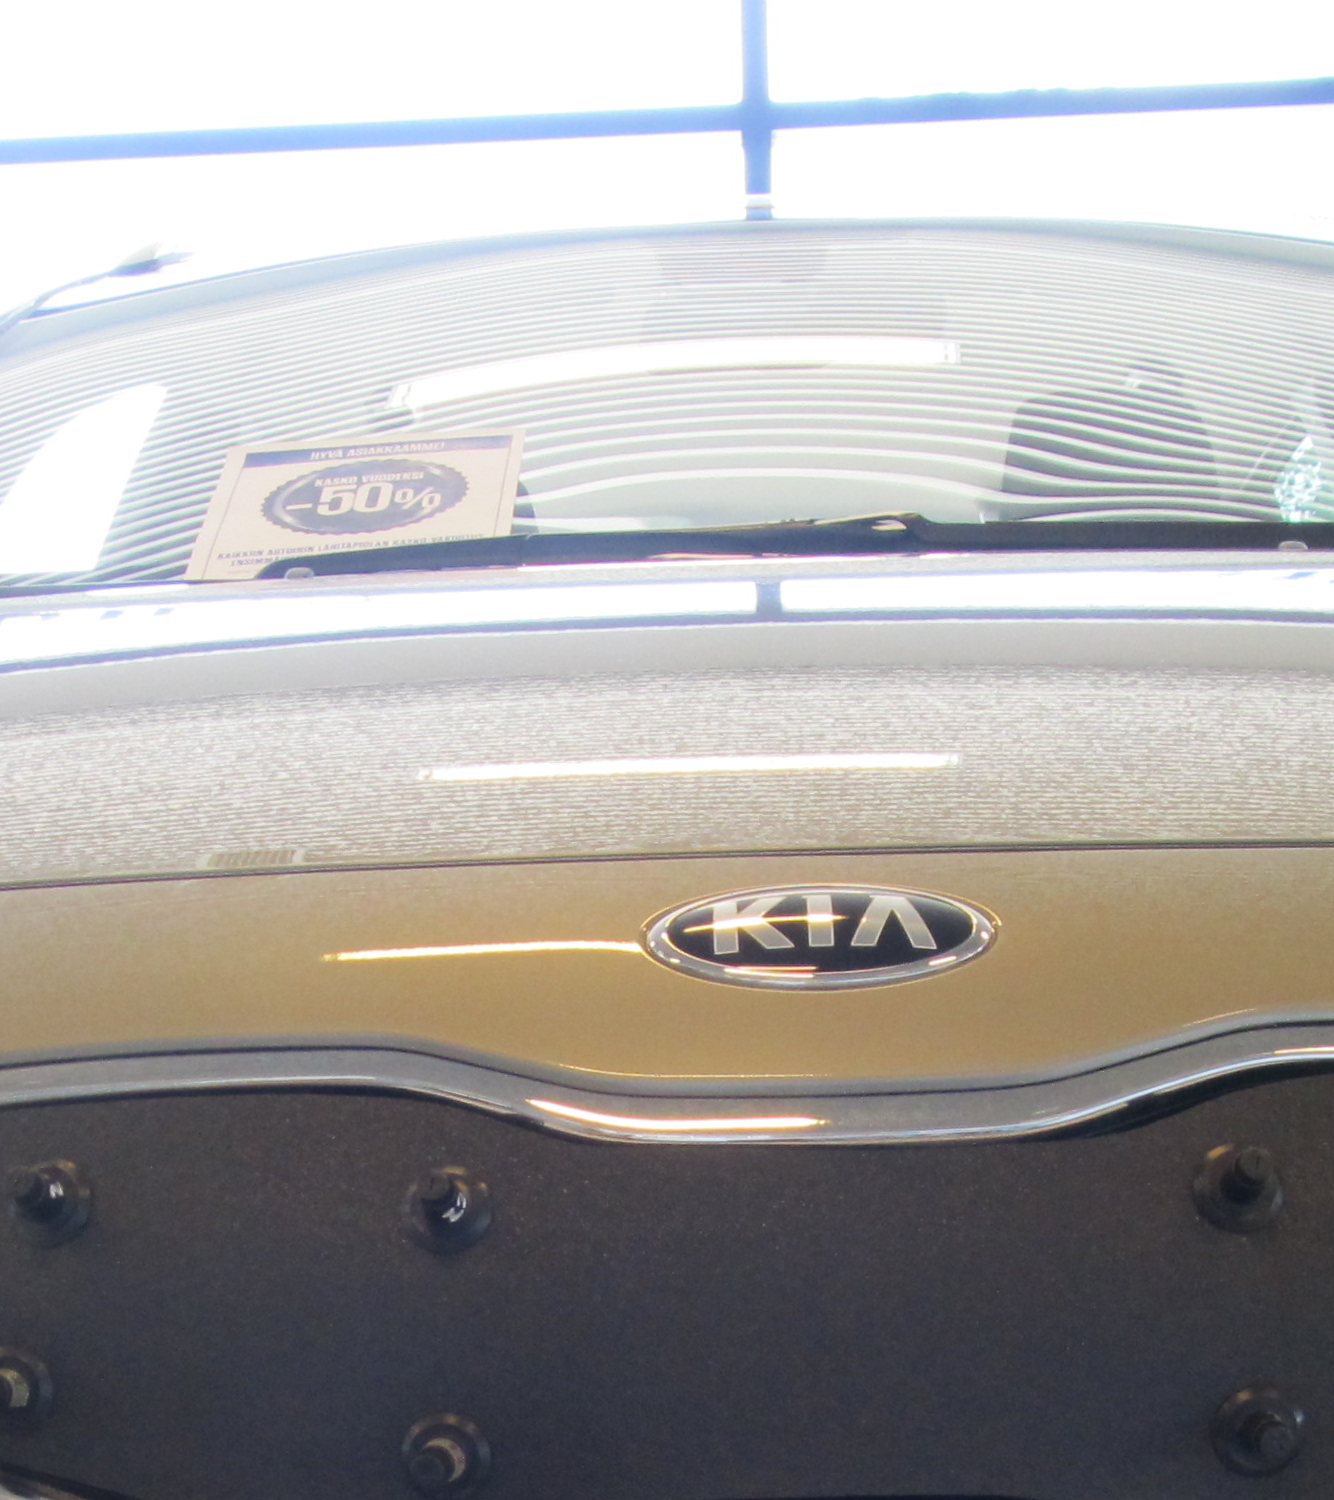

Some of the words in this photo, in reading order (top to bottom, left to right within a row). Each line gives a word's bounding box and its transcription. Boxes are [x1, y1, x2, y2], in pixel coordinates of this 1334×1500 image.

[285, 481, 442, 517] -50%
[314, 475, 358, 487] KASKO
[712, 894, 937, 955] KIA
